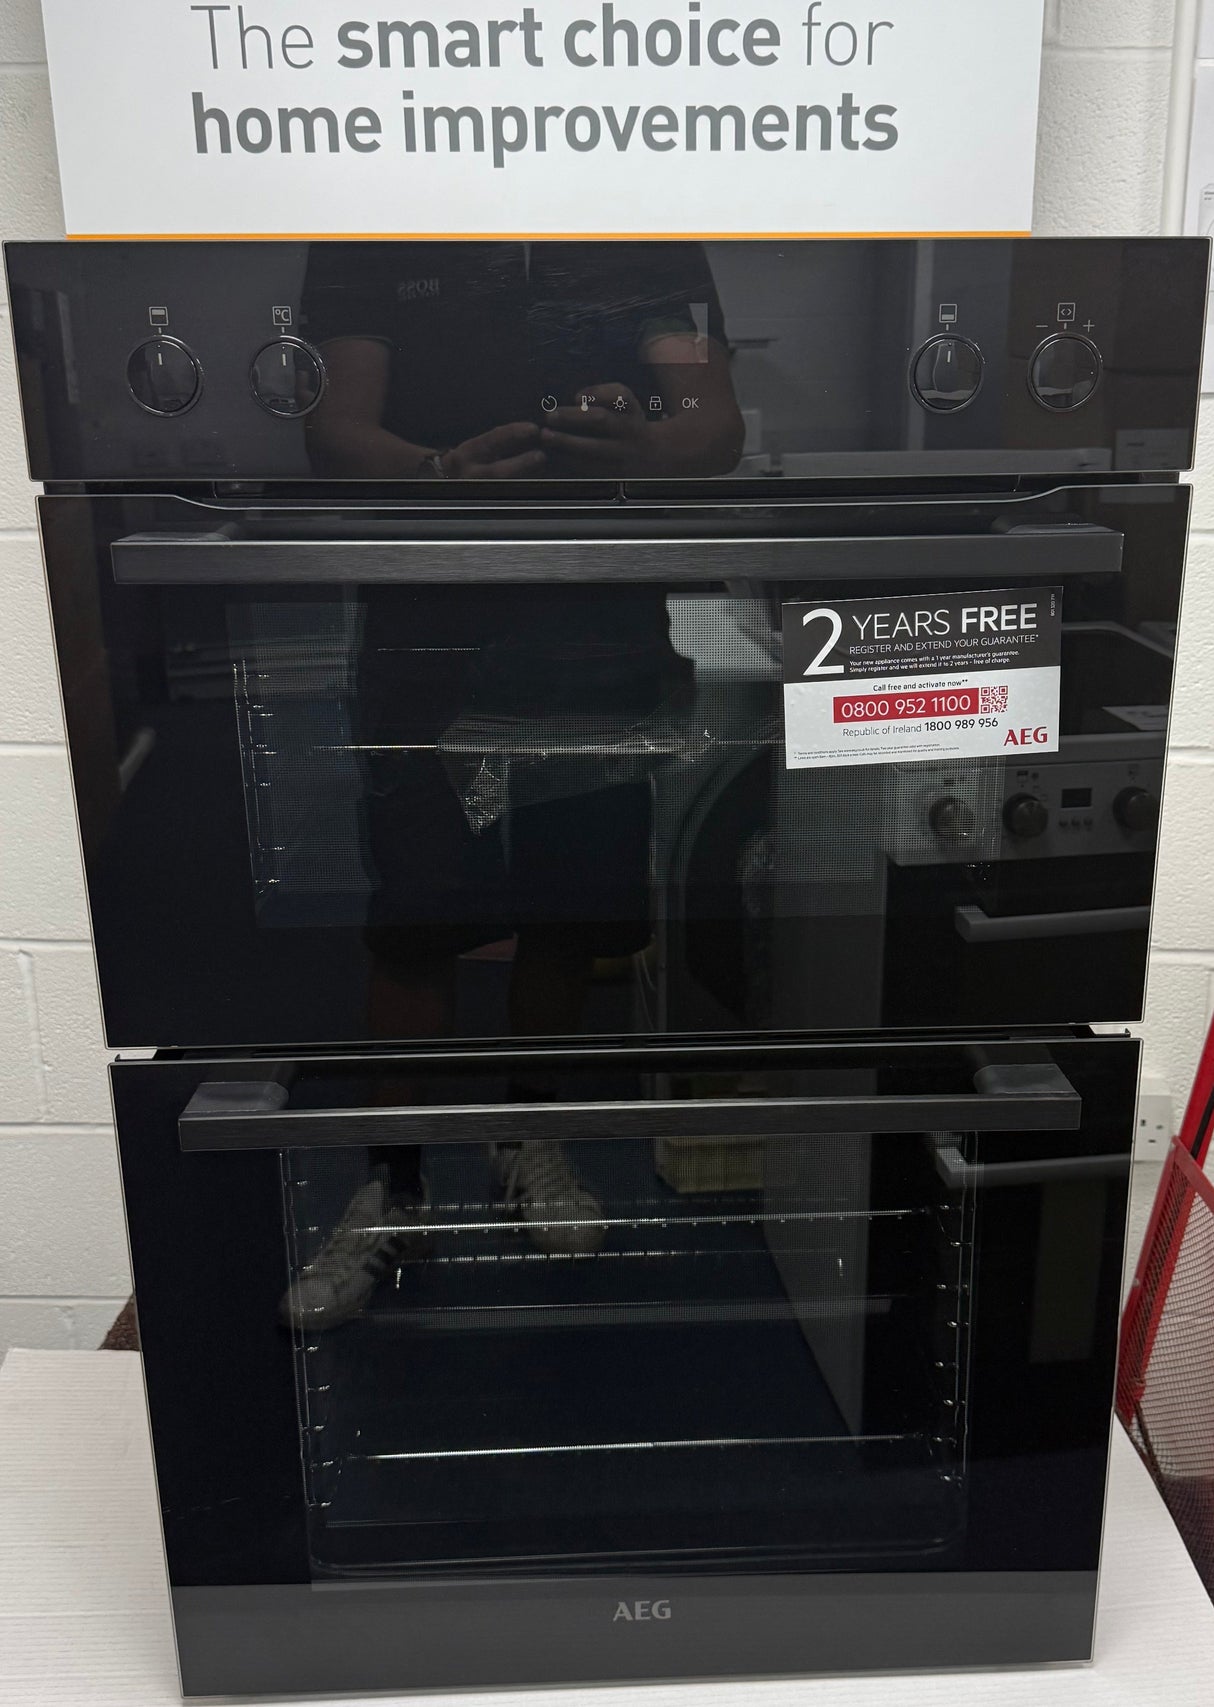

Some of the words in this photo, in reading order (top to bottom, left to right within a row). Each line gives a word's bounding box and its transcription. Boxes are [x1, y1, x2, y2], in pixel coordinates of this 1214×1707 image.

[191, 5, 313, 69] The
[338, 8, 543, 68] smart
[564, 2, 780, 67] choice
[802, 2, 894, 65] for
[192, 92, 381, 153] home
[403, 90, 898, 168] improvements
[682, 397, 699, 409] OK
[802, 608, 845, 676] 2
[852, 609, 950, 641] YEARS
[961, 603, 1038, 633] FREE
[849, 644, 892, 655] REGISTER
[894, 642, 913, 652] AND
[916, 640, 952, 651] EXTEND
[954, 638, 979, 648] YOUR
[849, 666, 868, 674] Simply
[868, 665, 888, 673] register
[919, 661, 937, 669] extend
[991, 657, 1010, 665] charge.
[875, 658, 900, 666] appliance
[952, 651, 991, 660] manufacturer's
[992, 650, 1020, 658] guarantee.
[873, 684, 886, 692] Call
[888, 683, 902, 691] free
[903, 682, 917, 690] and
[918, 681, 946, 689] activate
[841, 700, 889, 718] 0800
[895, 698, 926, 714] 952
[931, 695, 971, 712] 1100
[843, 726, 880, 738] Republic
[882, 725, 891, 735] of
[893, 723, 922, 734] Ireland
[924, 720, 952, 732] 1800
[955, 718, 976, 730] 989
[978, 717, 998, 728] 956
[1003, 726, 1048, 746] AEG
[613, 1600, 672, 1622] AEG
